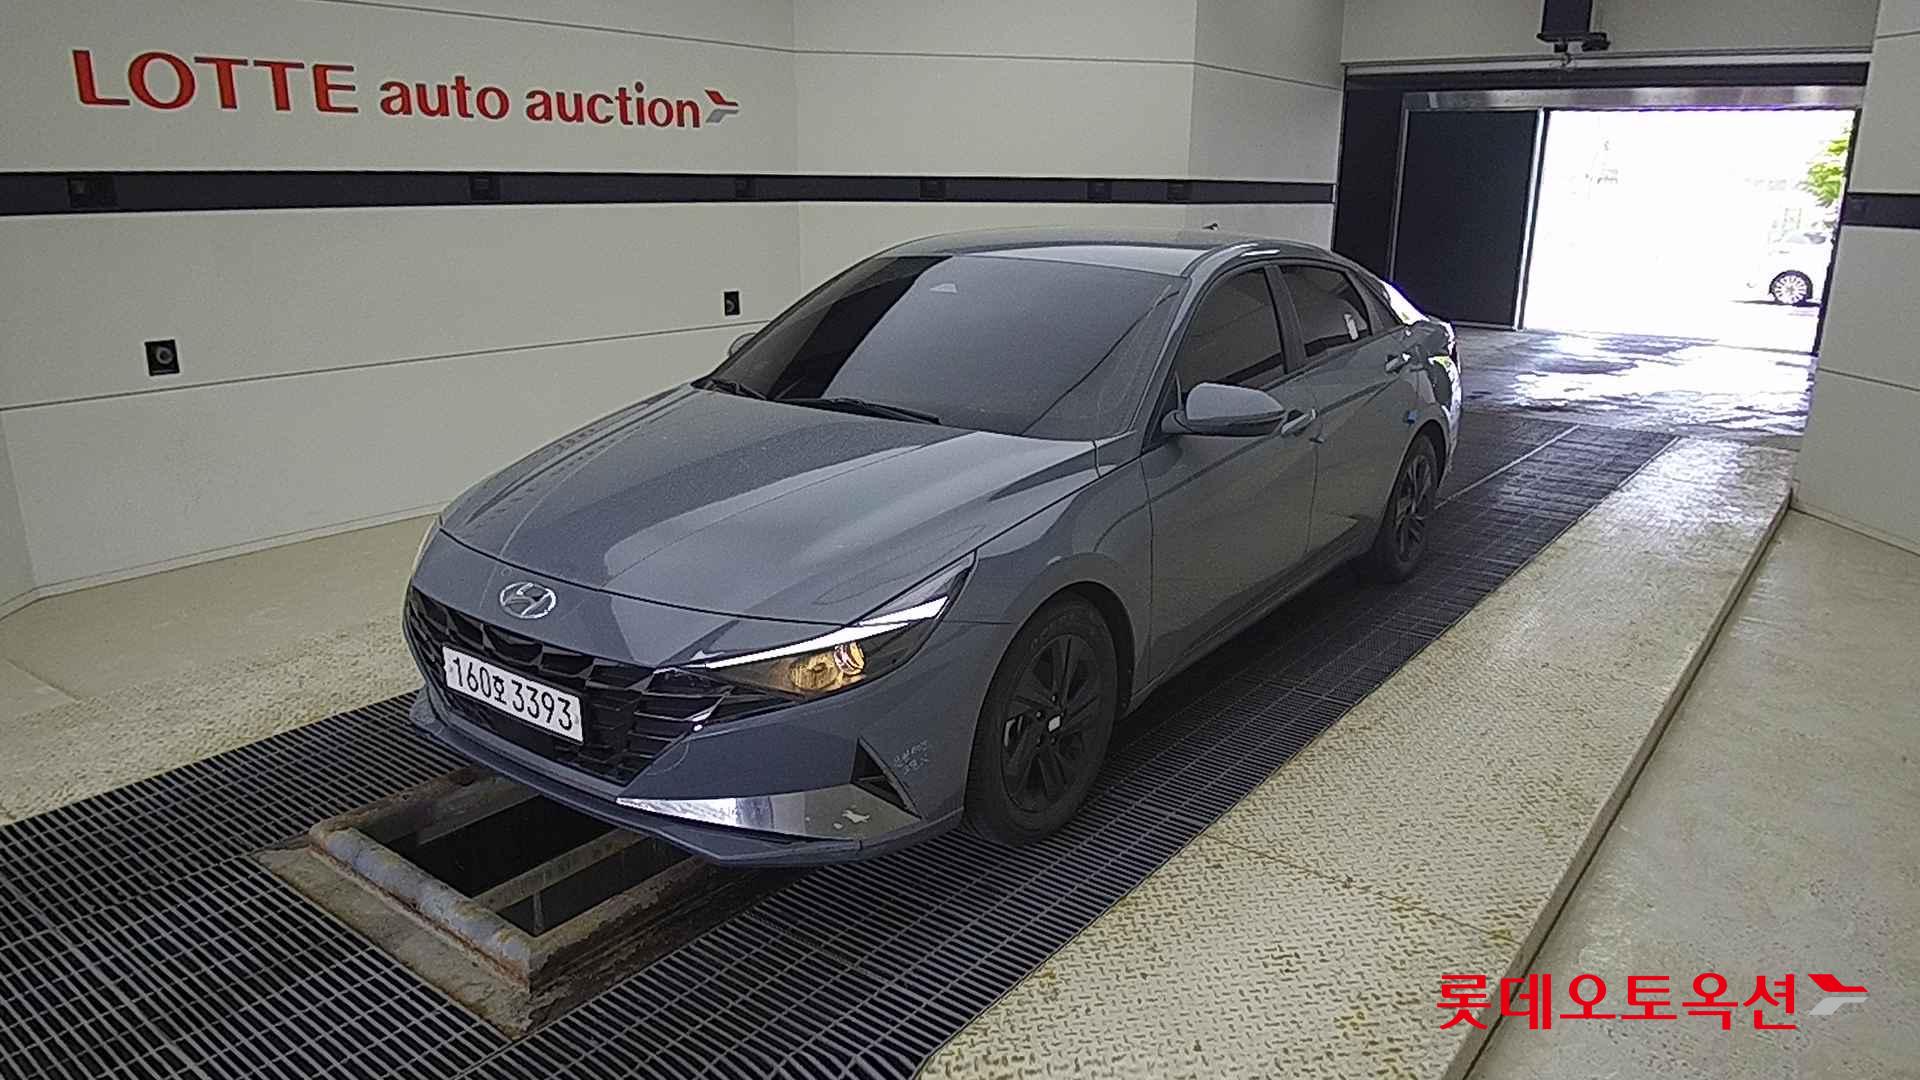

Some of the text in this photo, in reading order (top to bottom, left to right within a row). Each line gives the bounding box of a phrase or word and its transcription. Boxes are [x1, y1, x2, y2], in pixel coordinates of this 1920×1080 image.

[72, 48, 702, 128] LOTTE auto auction
